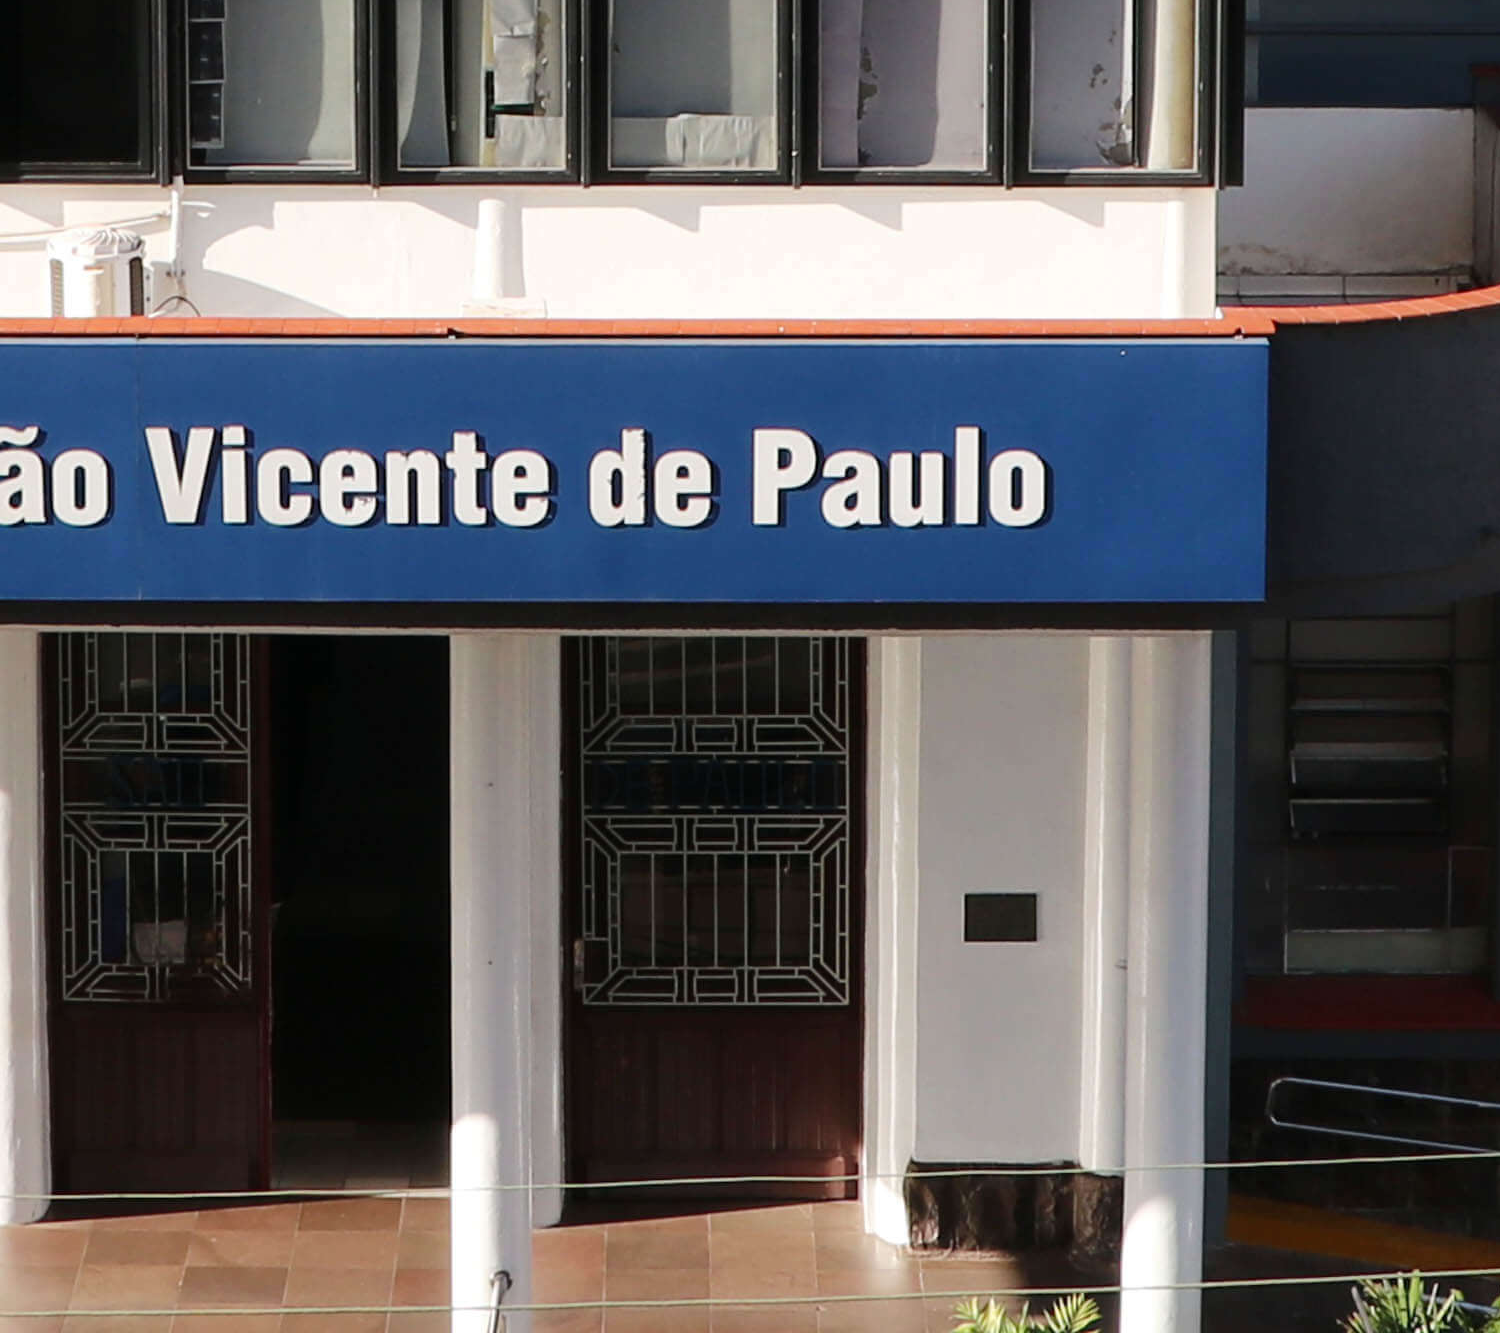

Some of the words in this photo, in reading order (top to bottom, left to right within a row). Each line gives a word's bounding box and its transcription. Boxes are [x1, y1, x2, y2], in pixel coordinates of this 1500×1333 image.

[144, 424, 552, 528] Vicente
[589, 427, 715, 529] de
[751, 425, 1047, 529] Paulo
